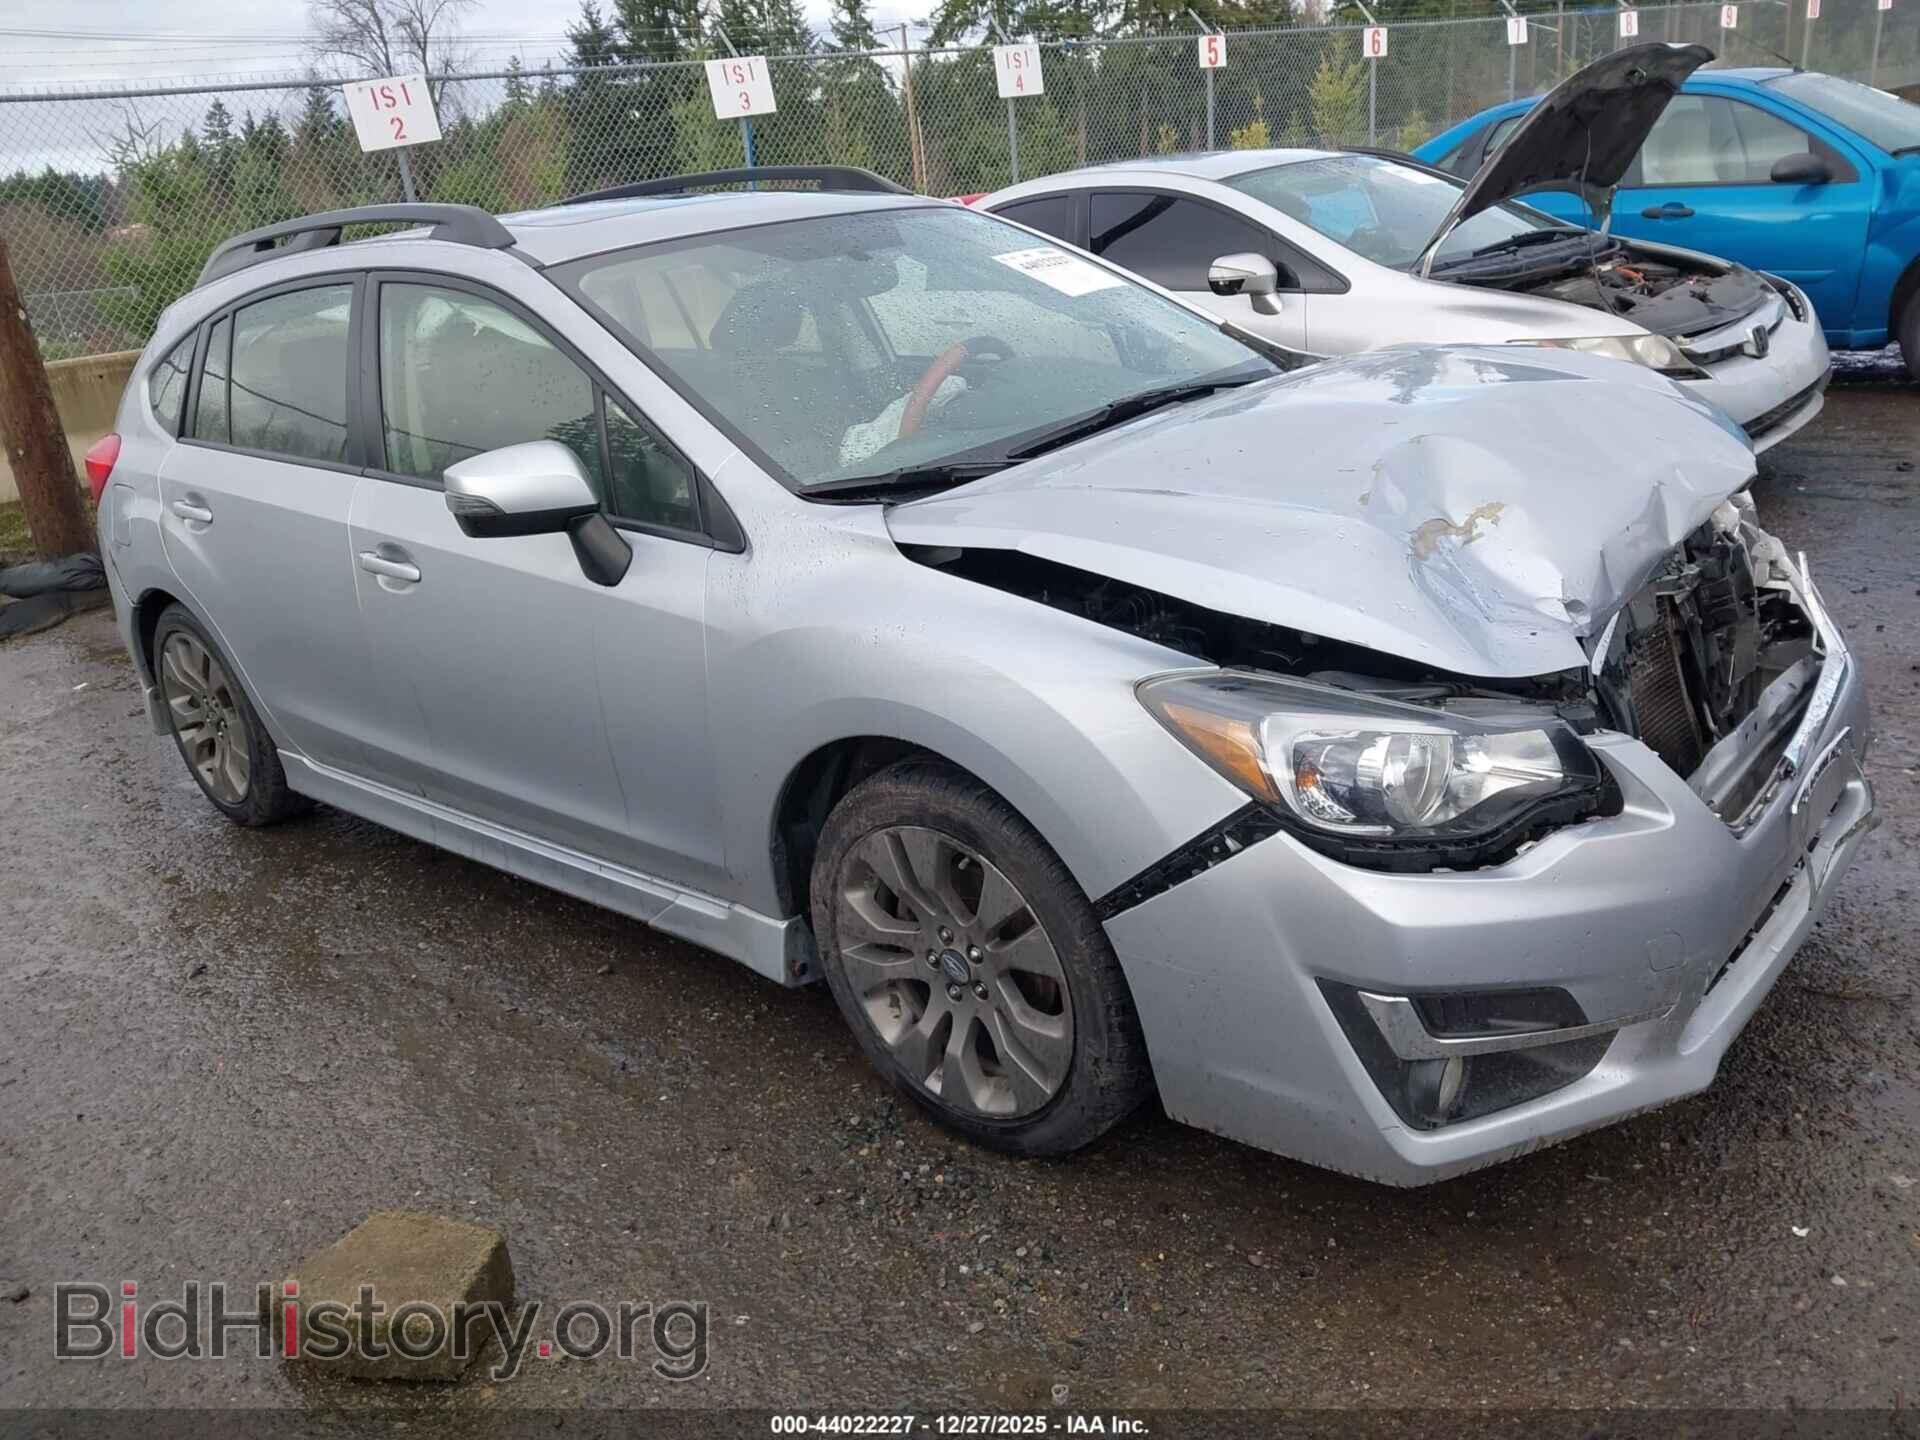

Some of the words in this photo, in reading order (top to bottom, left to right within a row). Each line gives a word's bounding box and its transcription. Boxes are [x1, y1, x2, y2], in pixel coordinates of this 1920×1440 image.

[1513, 19, 1521, 42] 7
[1625, 13, 1633, 34] 8
[1206, 37, 1218, 66] 5
[1371, 29, 1381, 54] 6
[1015, 74, 1024, 92] 4
[739, 91, 751, 111] 3
[390, 117, 407, 141] 2
